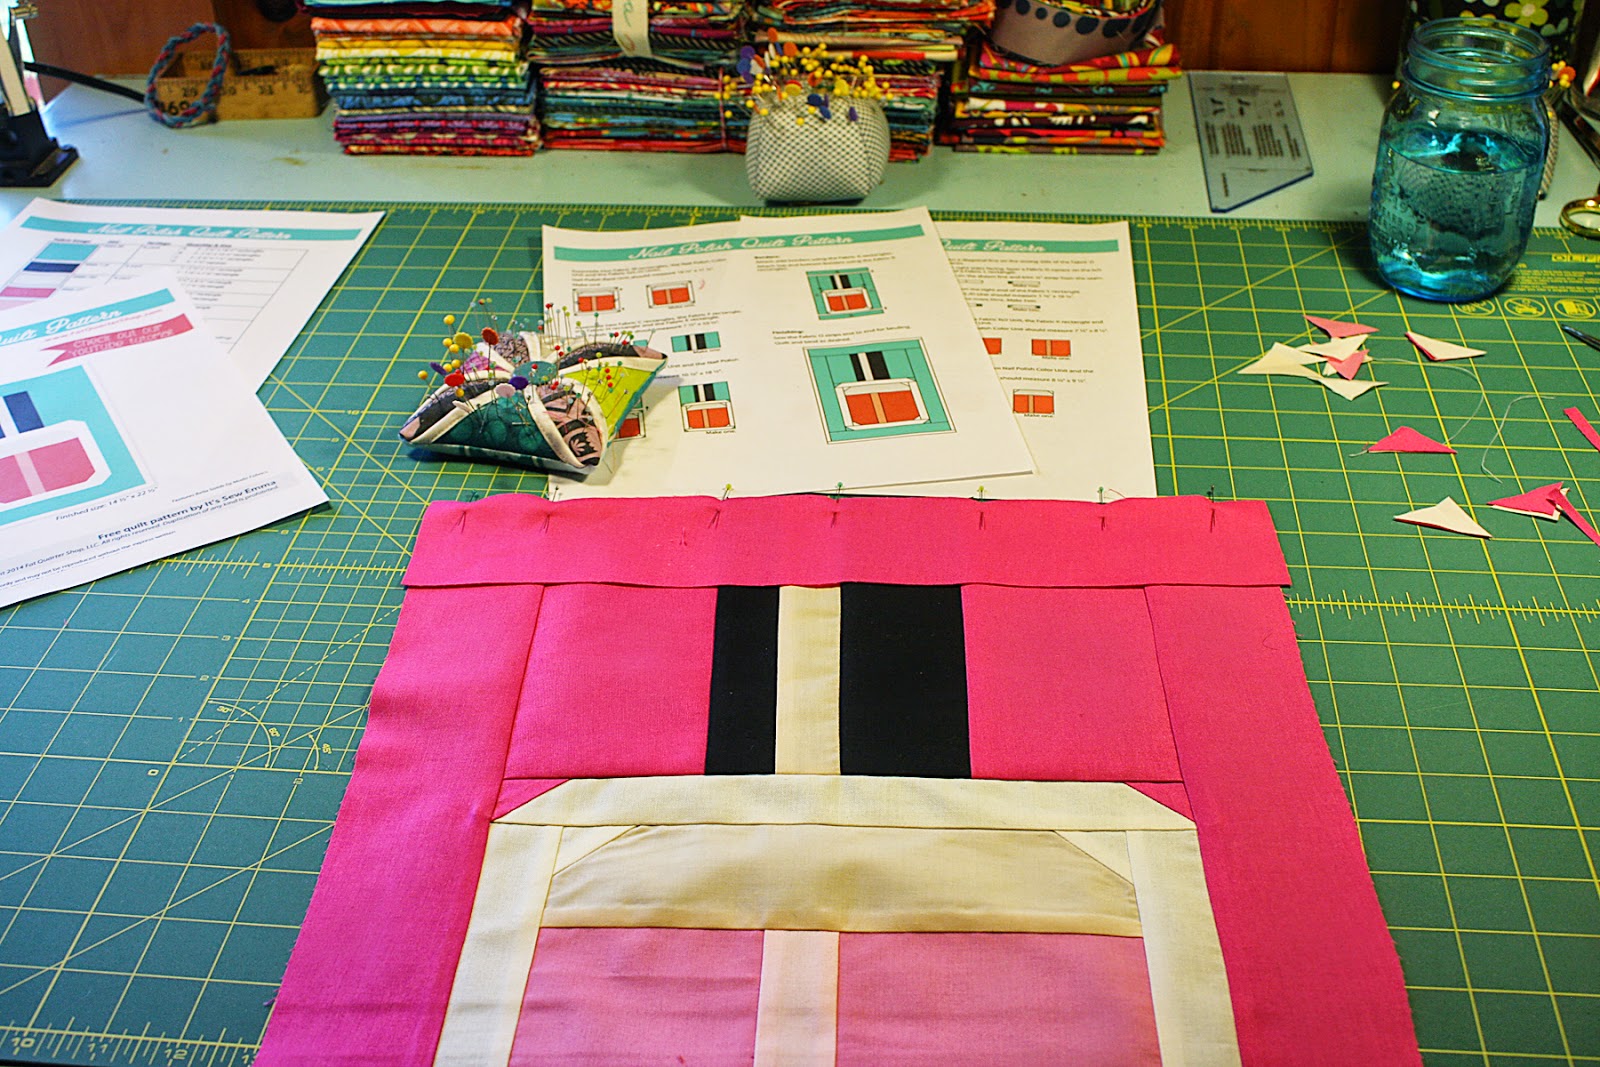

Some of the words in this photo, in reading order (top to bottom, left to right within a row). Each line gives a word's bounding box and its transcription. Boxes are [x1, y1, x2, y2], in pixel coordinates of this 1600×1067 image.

[628, 245, 673, 260] Nail
[678, 240, 734, 255] Polish
[740, 237, 787, 249] Quilt
[791, 234, 854, 247] Pattern
[982, 240, 1046, 253] Pattern
[0, 328, 38, 346] uilt
[46, 309, 122, 335] Pattern
[55, 508, 89, 521] Finished
[98, 530, 121, 540] Free
[123, 520, 148, 533] quilt
[150, 508, 189, 526] pattern
[190, 503, 203, 512] by
[205, 499, 220, 508] It's
[221, 491, 243, 502] Sew
[244, 479, 277, 495] Emma
[7, 564, 24, 575] 2014
[37, 551, 65, 565] Quarter
[147, 768, 160, 777] 0
[11, 1037, 35, 1049] 10
[88, 1042, 109, 1054] 11
[165, 1048, 188, 1060] 12
